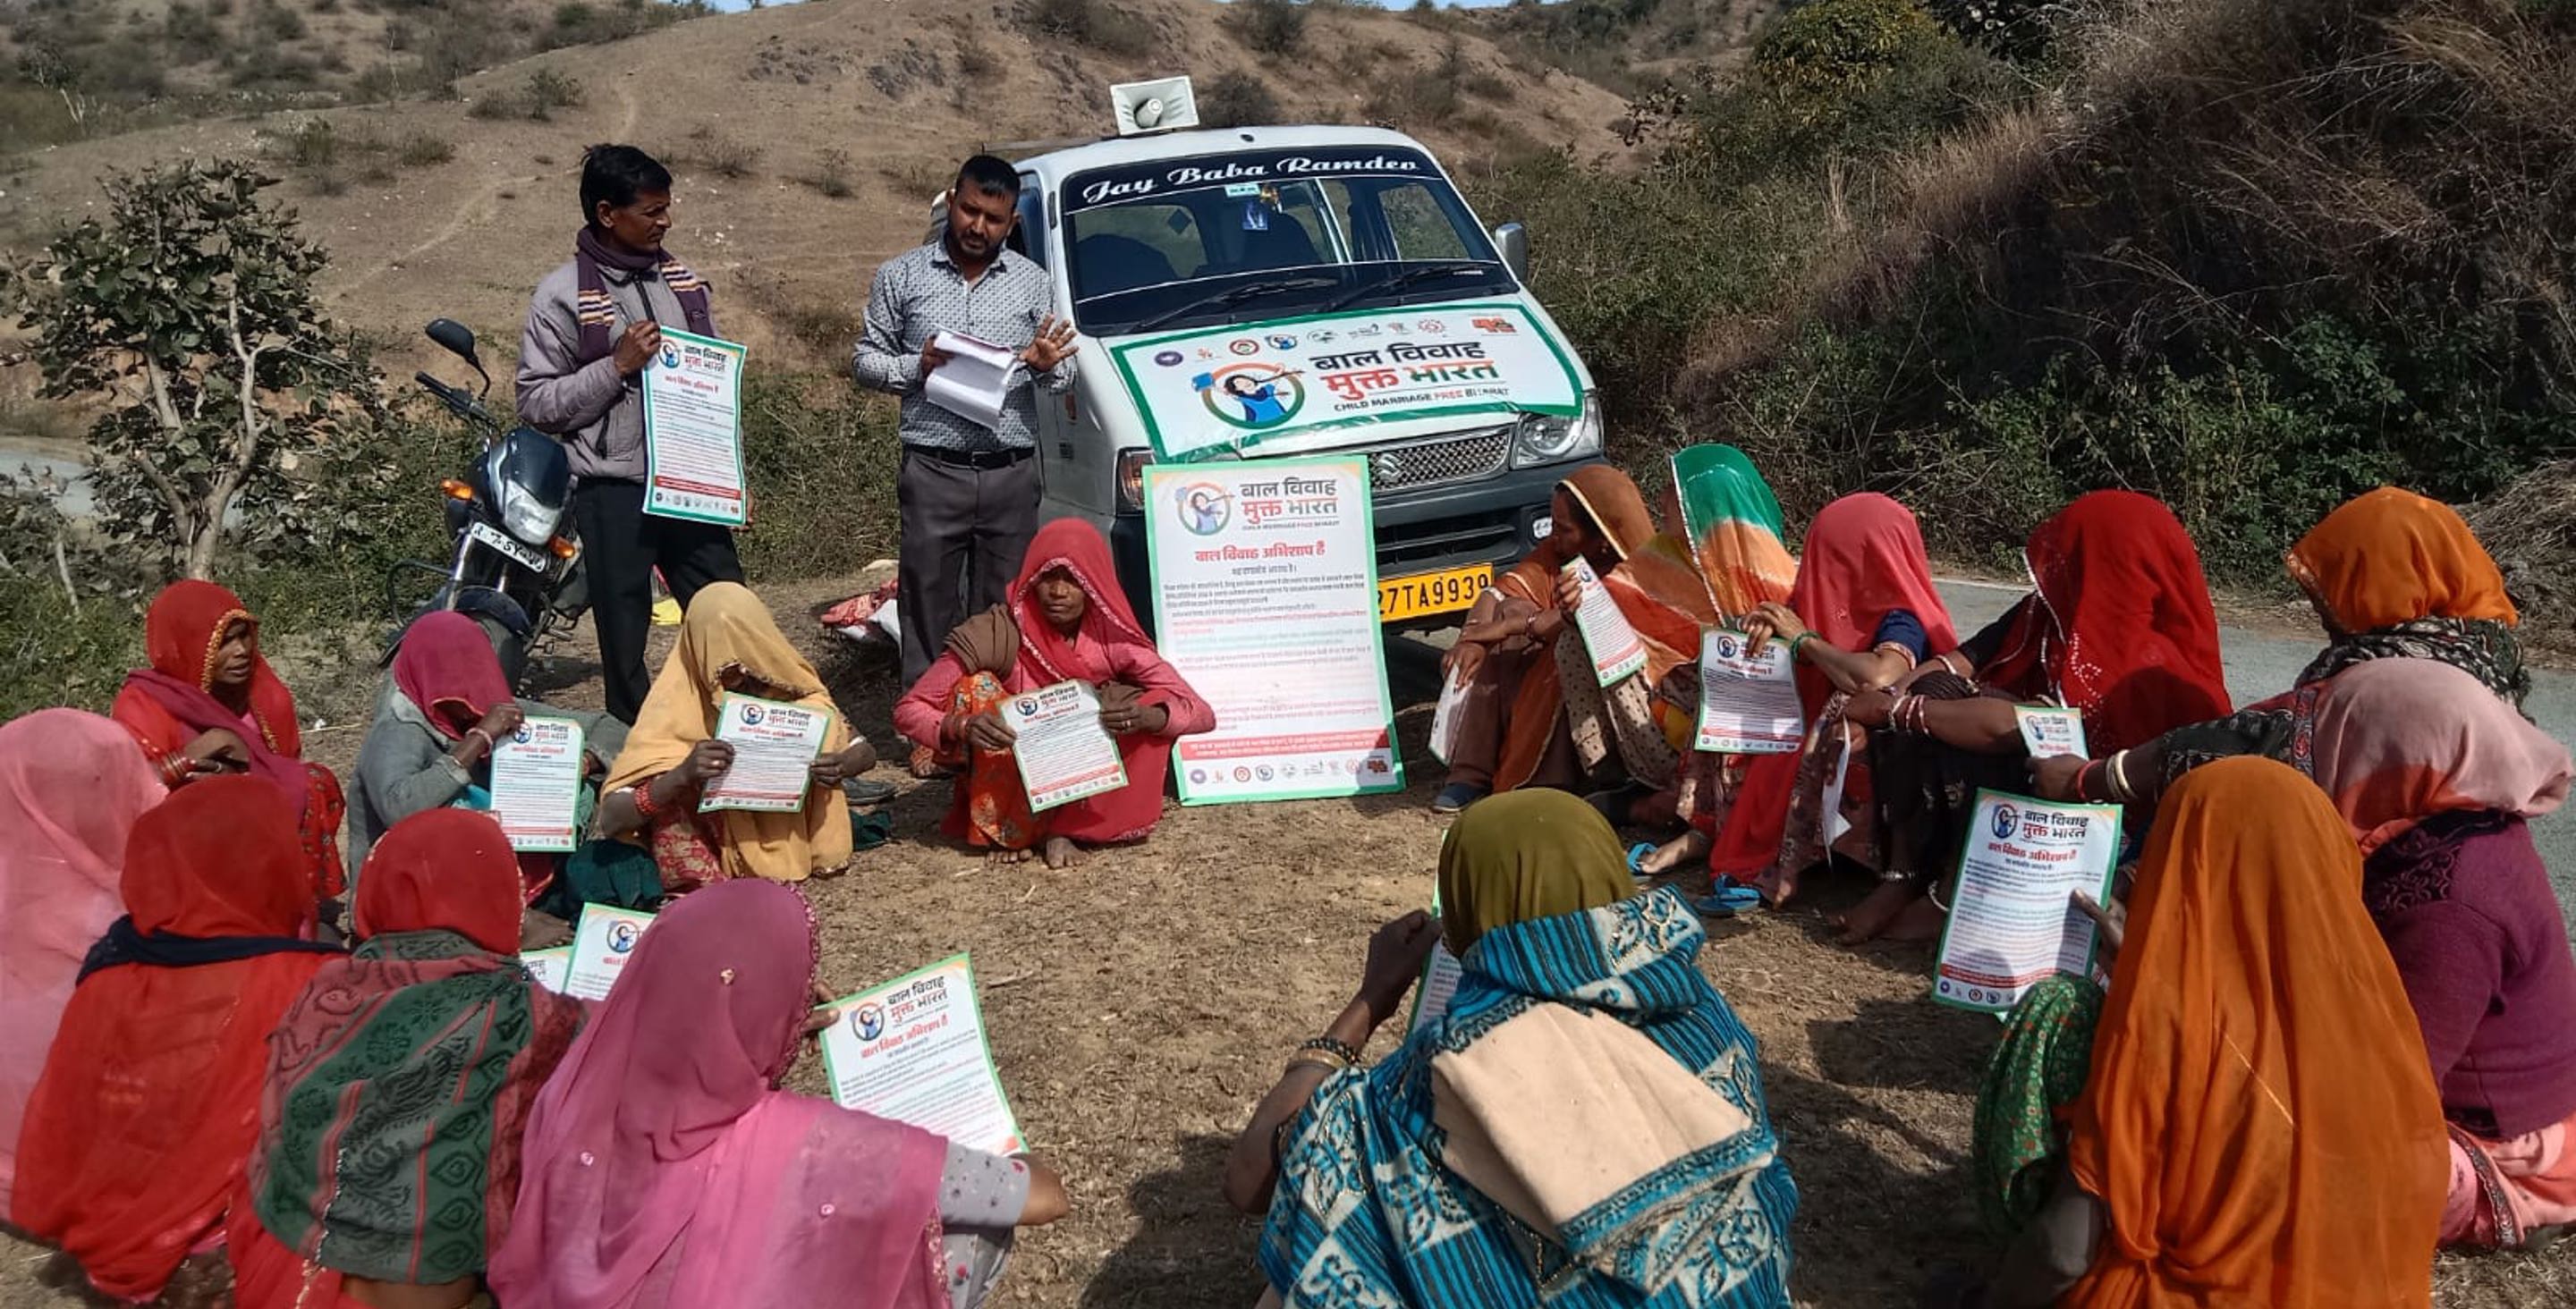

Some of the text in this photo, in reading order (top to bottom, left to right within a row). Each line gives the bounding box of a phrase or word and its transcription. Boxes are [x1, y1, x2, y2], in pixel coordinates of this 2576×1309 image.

[1082, 156, 1419, 204] Jay Baba Ramdev
[1309, 342, 1486, 370] बाल विवाह
[1319, 359, 1500, 401] मुक्त भारत
[1334, 401, 1369, 412] CHILD
[1371, 393, 1432, 407] MARRIAGE
[1240, 477, 1337, 498] बाल विवाह
[1241, 497, 1339, 525] मुक्त भारत
